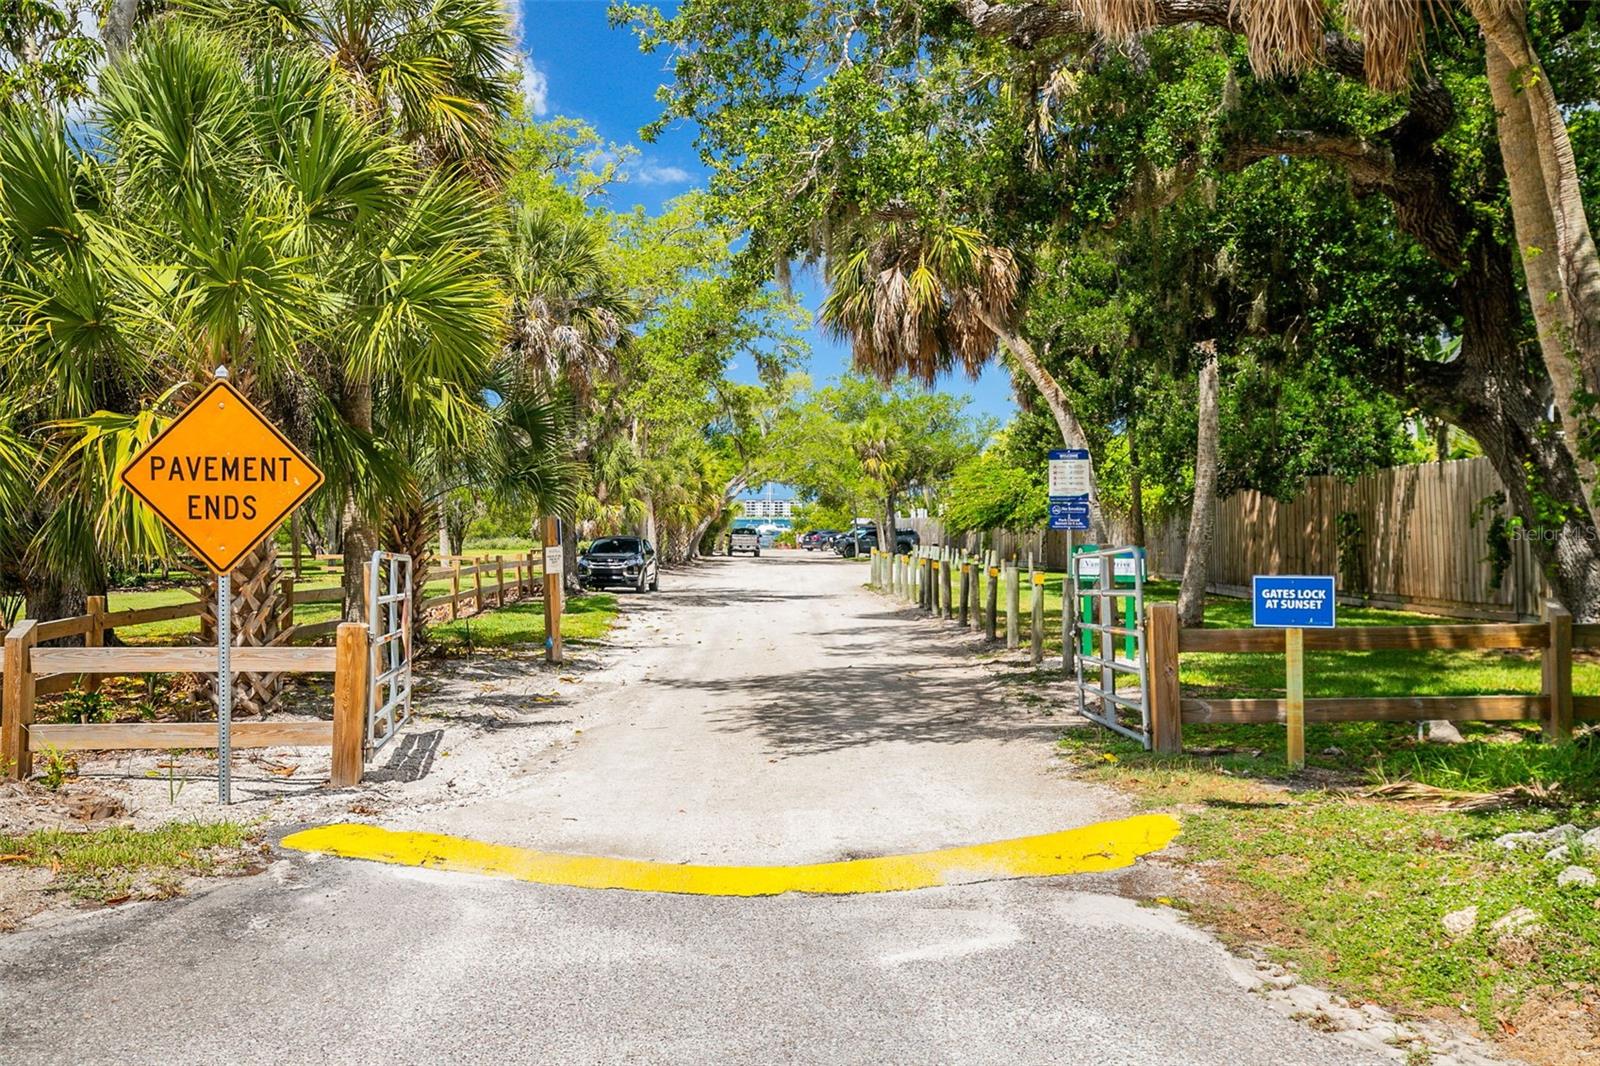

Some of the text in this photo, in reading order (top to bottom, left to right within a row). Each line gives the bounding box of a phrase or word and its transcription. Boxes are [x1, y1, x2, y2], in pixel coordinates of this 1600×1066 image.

[150, 455, 293, 483] PAVEMENT
[187, 494, 258, 521] ENDS
[1261, 588, 1326, 600] GATES LOCK
[1265, 599, 1323, 610] AT SUNSET
